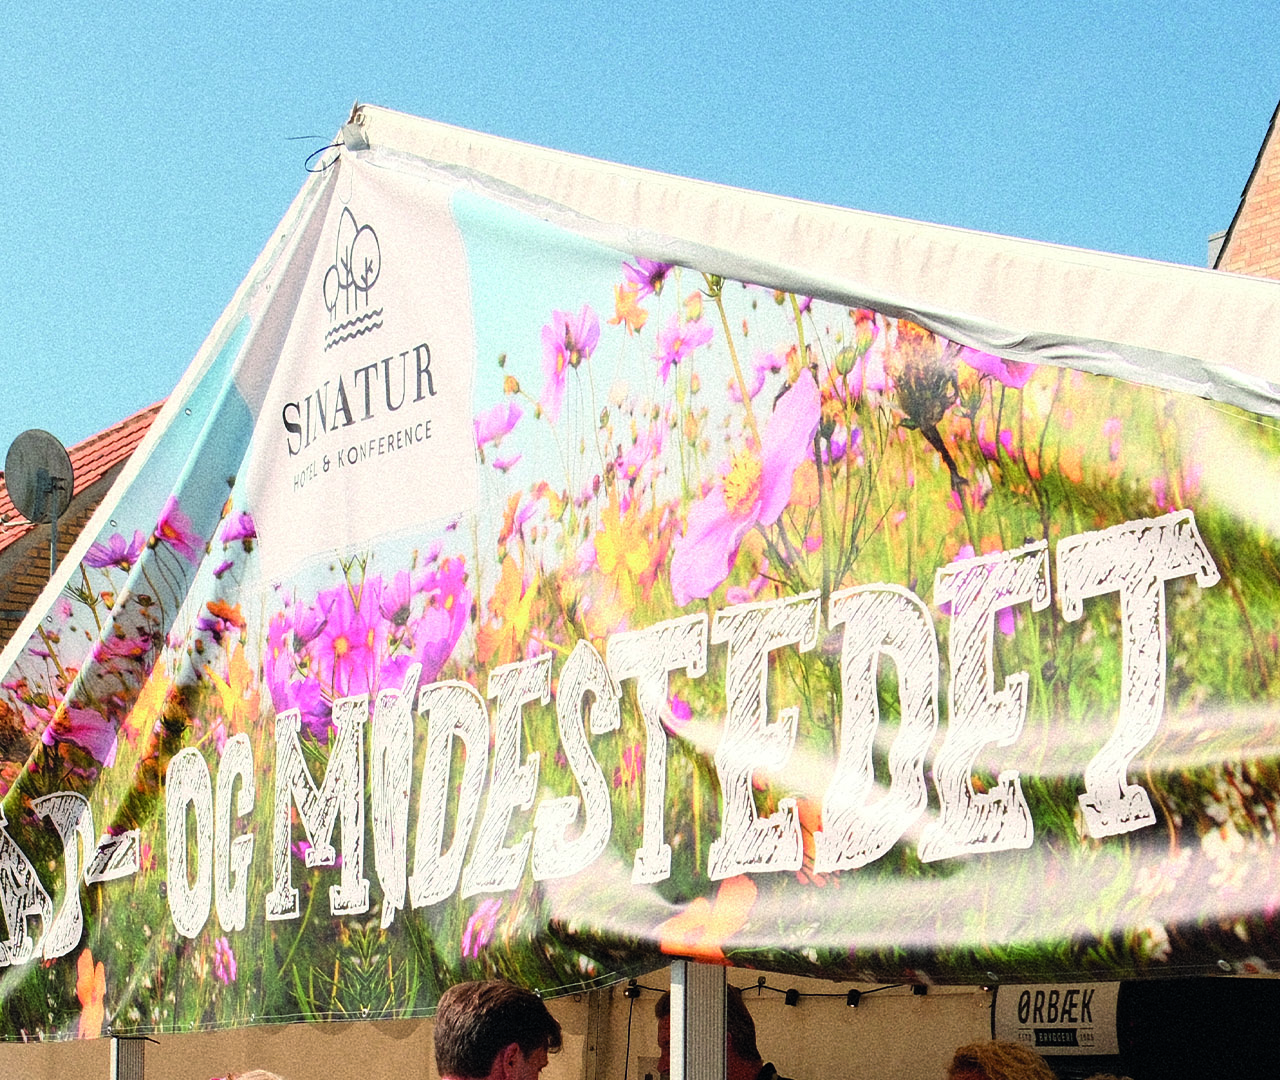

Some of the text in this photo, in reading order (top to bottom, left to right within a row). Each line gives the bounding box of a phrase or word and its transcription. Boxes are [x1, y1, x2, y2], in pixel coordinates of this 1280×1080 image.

[282, 342, 438, 458] SINATUR
[293, 419, 432, 493] HOTEL & KONFERENCE
[165, 738, 255, 939] OG
[265, 507, 1222, 926] MØDESTEDET
[1018, 989, 1095, 1024] ØRBÆK
